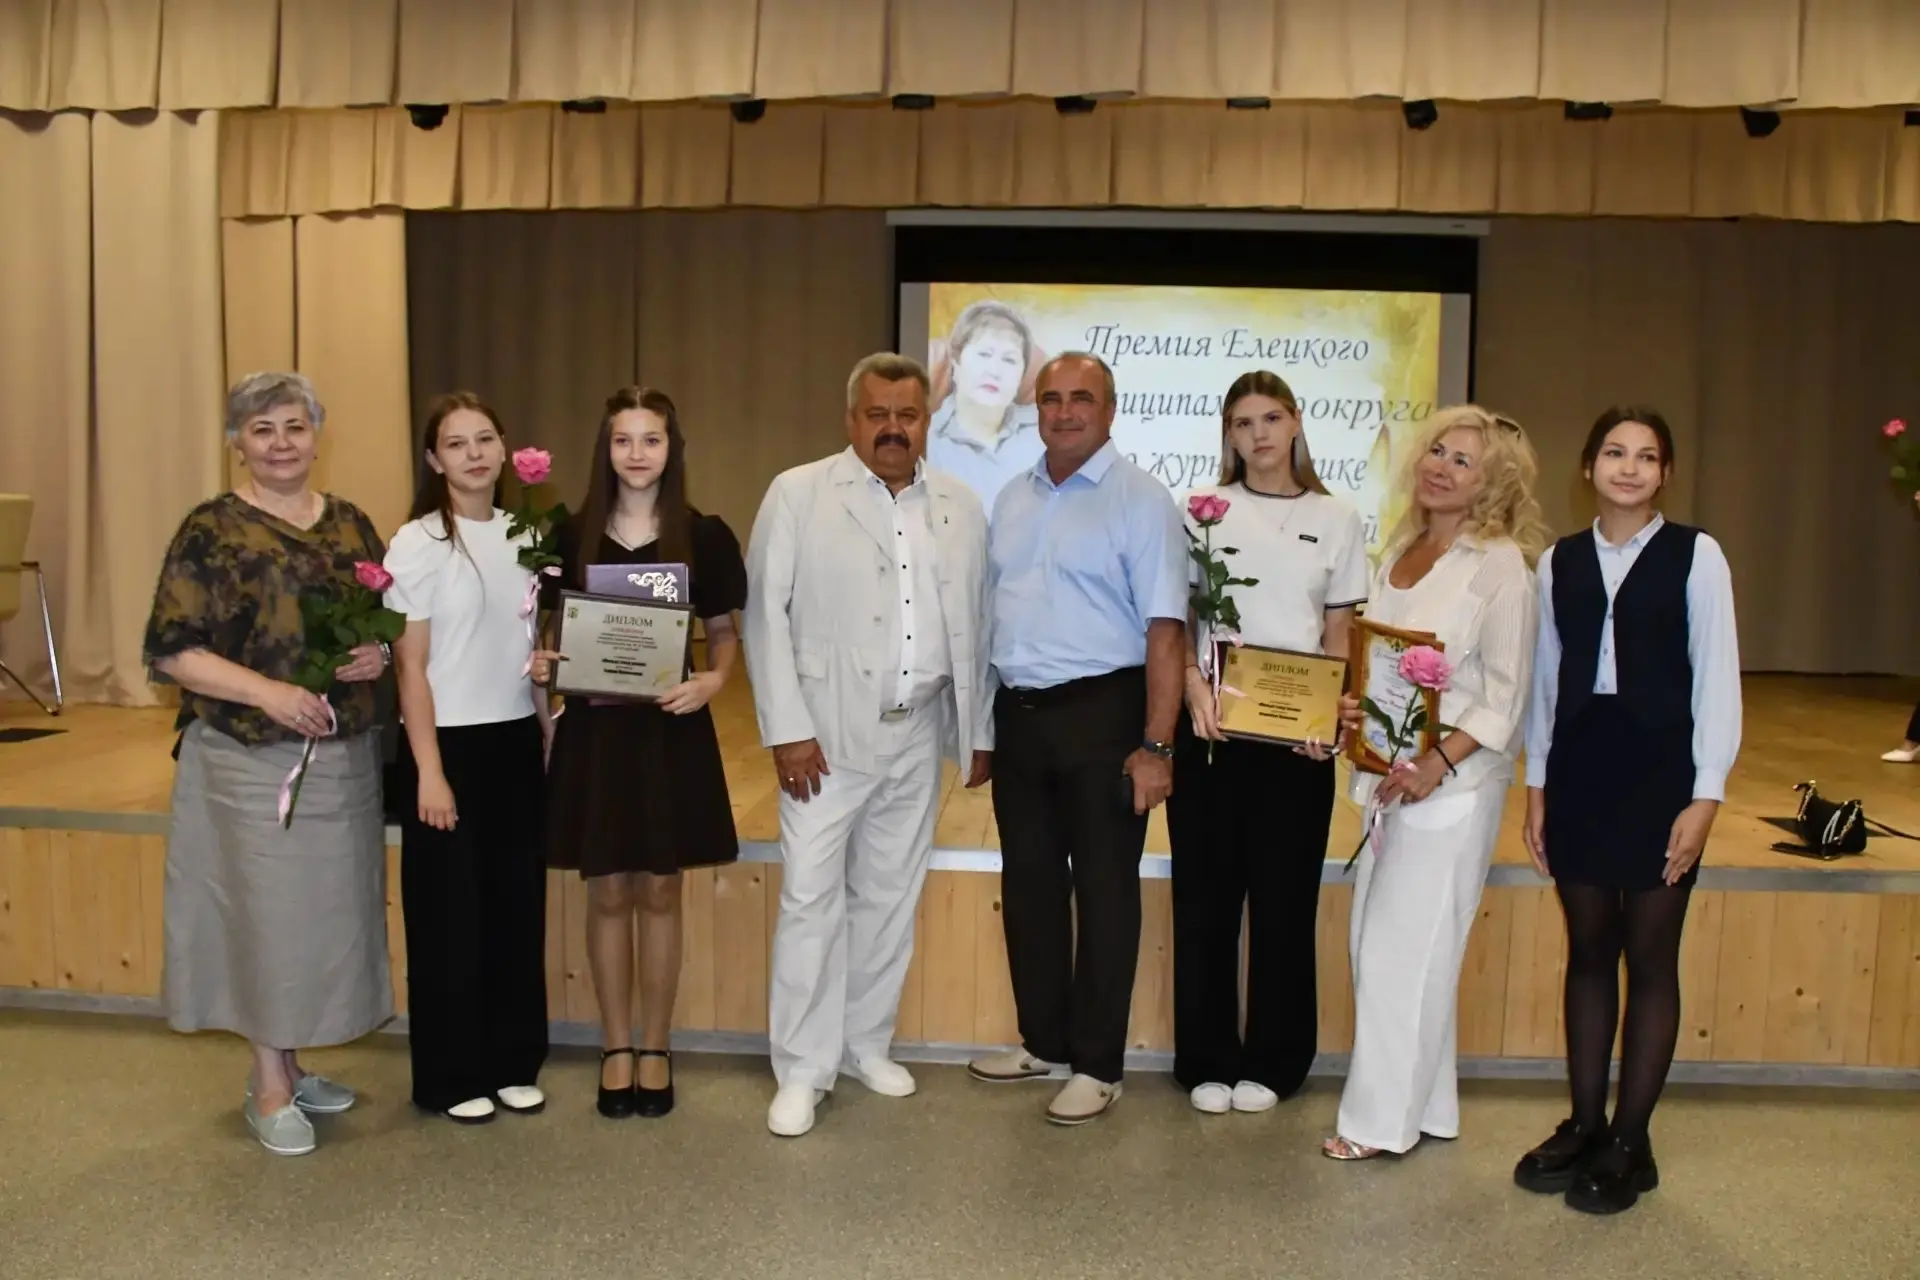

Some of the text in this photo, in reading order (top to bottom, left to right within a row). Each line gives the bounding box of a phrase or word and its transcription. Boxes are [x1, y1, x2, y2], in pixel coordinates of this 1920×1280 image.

[1085, 323, 1369, 369] Премия Елецкого
[1310, 399, 1433, 430] округа
[602, 613, 653, 628] ДИПЛОМ
[1260, 662, 1310, 677] ДИПЛОМ
